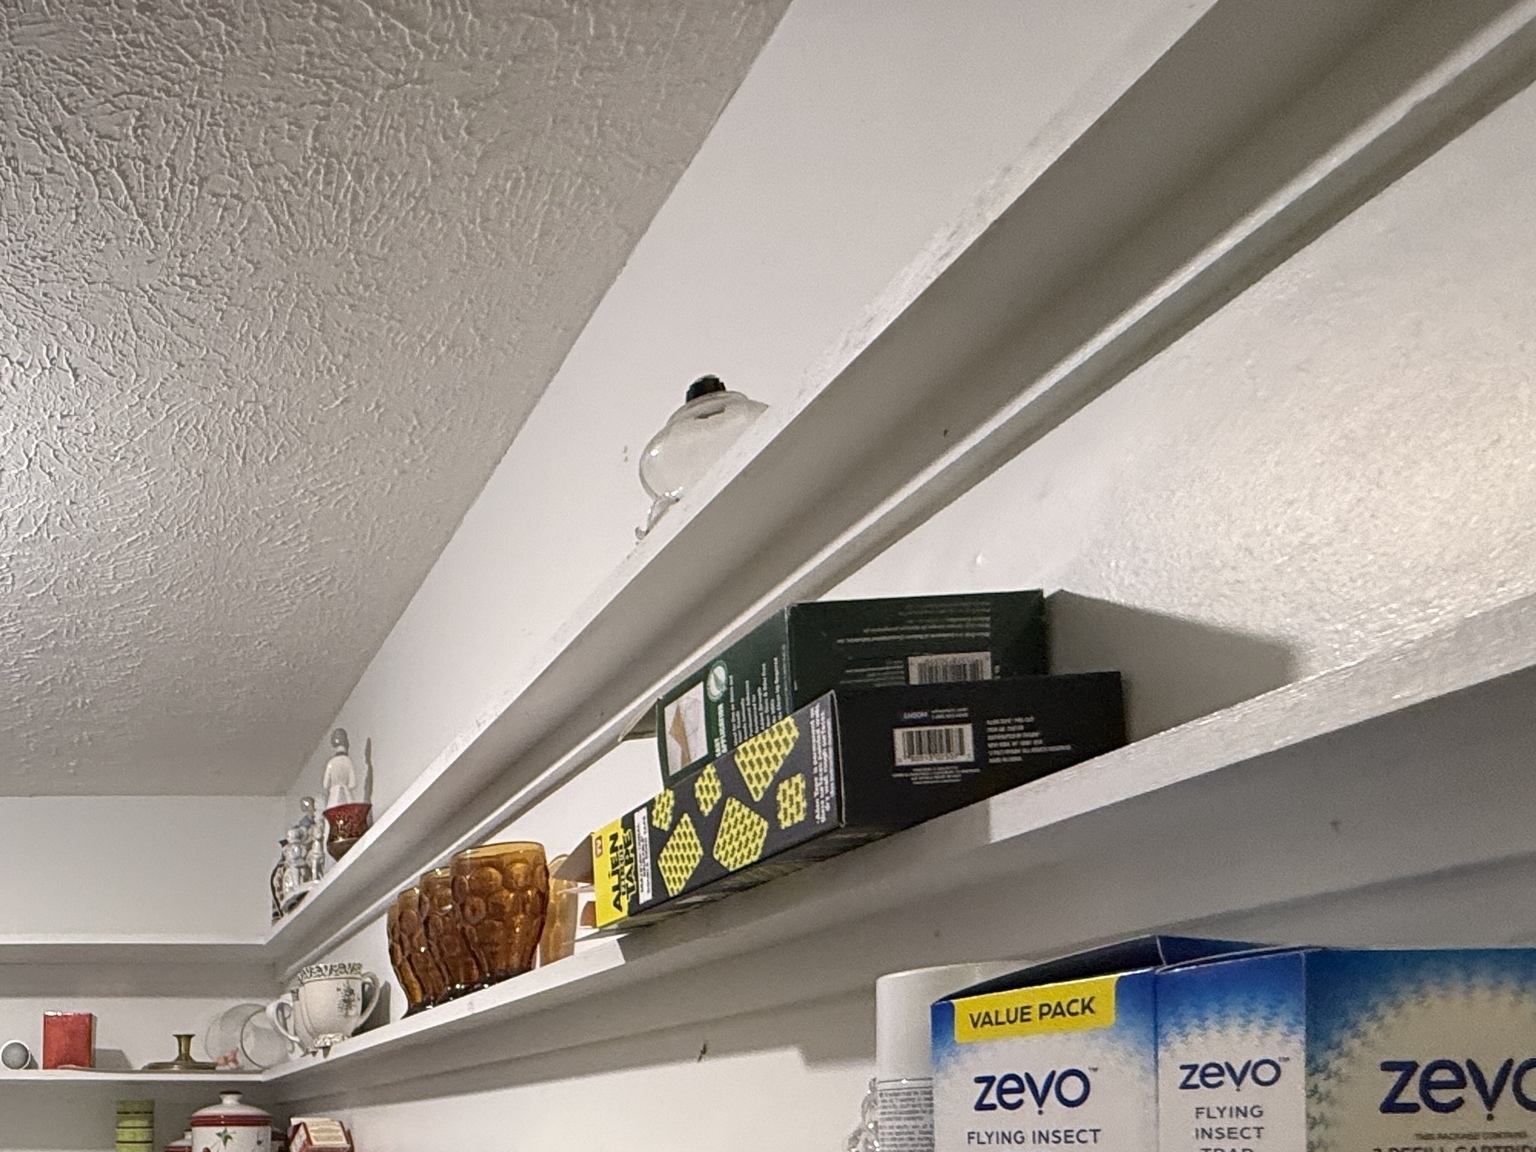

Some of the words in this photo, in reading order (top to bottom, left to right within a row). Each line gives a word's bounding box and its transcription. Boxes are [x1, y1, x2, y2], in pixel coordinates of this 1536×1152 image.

[608, 832, 623, 912] ALIEN
[621, 829, 636, 900] TAPE
[969, 1005, 1032, 1029] VALUE
[1038, 997, 1096, 1021] PACK
[1195, 1105, 1264, 1119] FLYING
[967, 1130, 1025, 1145] FLYING
[1032, 1129, 1101, 1144] INSECT
[1195, 1126, 1265, 1140] INSECT
